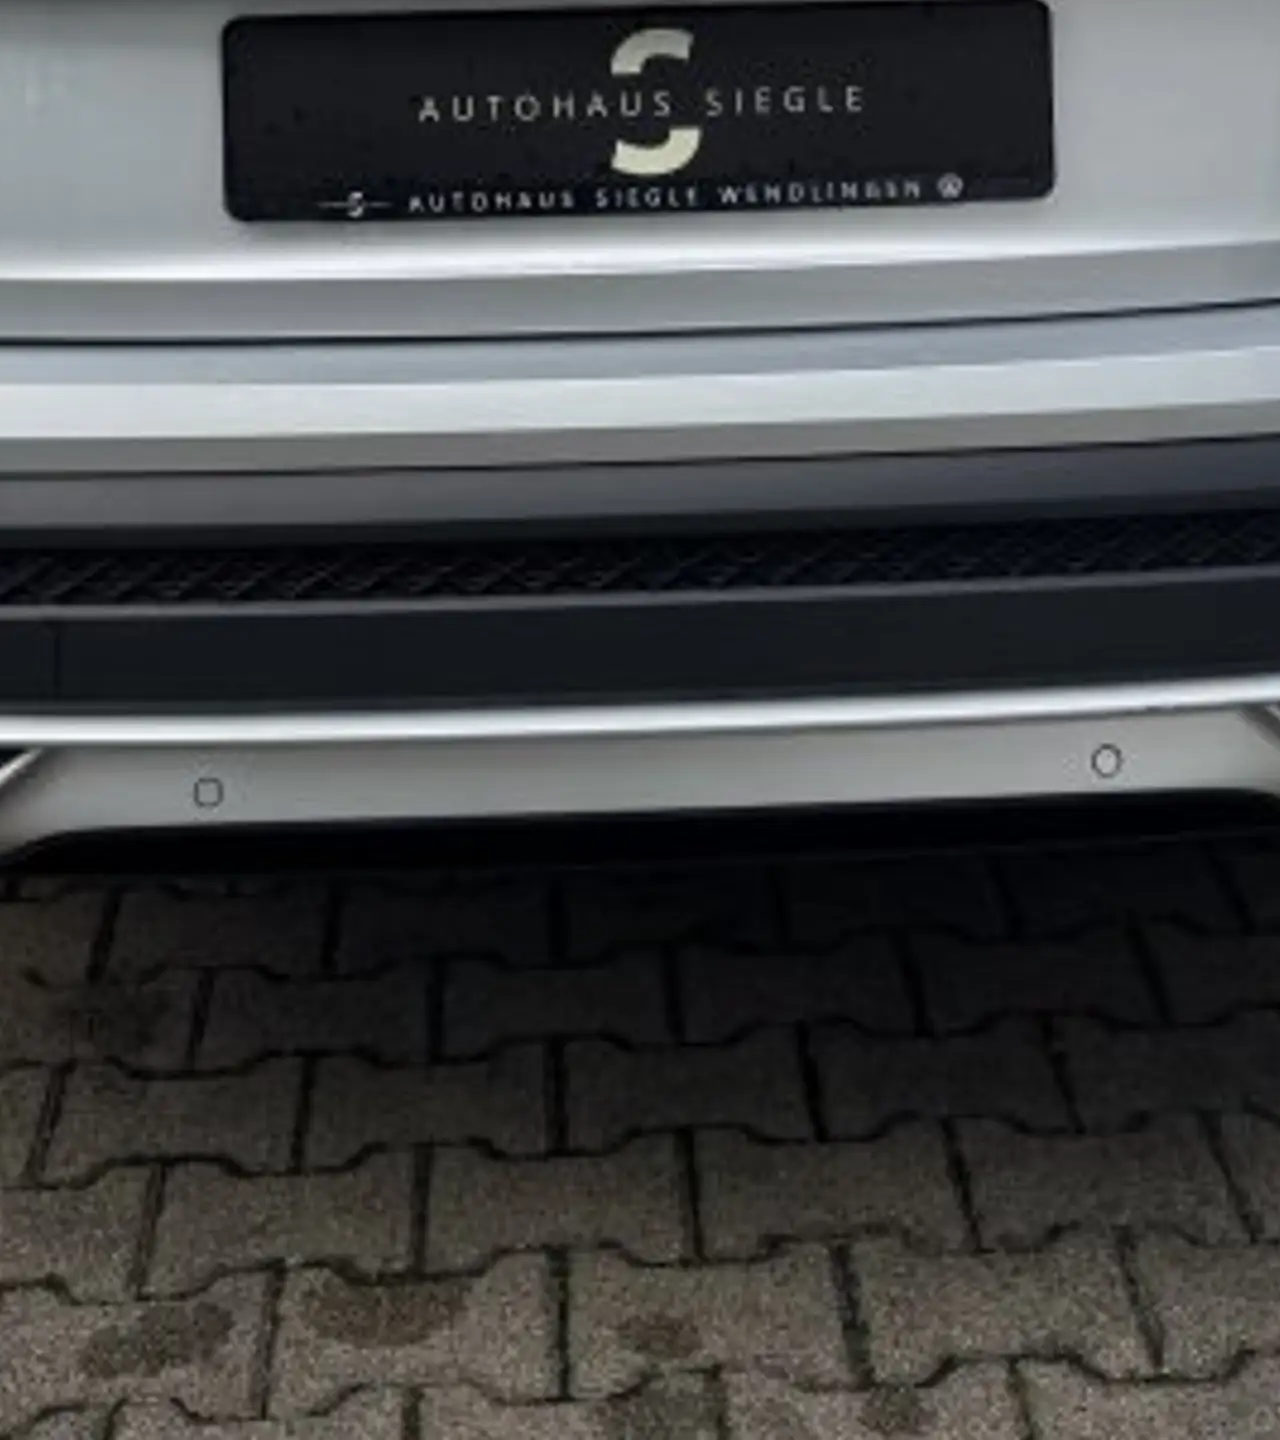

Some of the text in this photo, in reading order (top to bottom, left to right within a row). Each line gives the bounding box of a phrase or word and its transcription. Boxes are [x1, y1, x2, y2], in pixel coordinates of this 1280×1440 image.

[419, 85, 864, 122] AUTOHAUS SIEGLE
[408, 188, 575, 213] AUTOHAUS
[595, 184, 699, 209] SIEGLE
